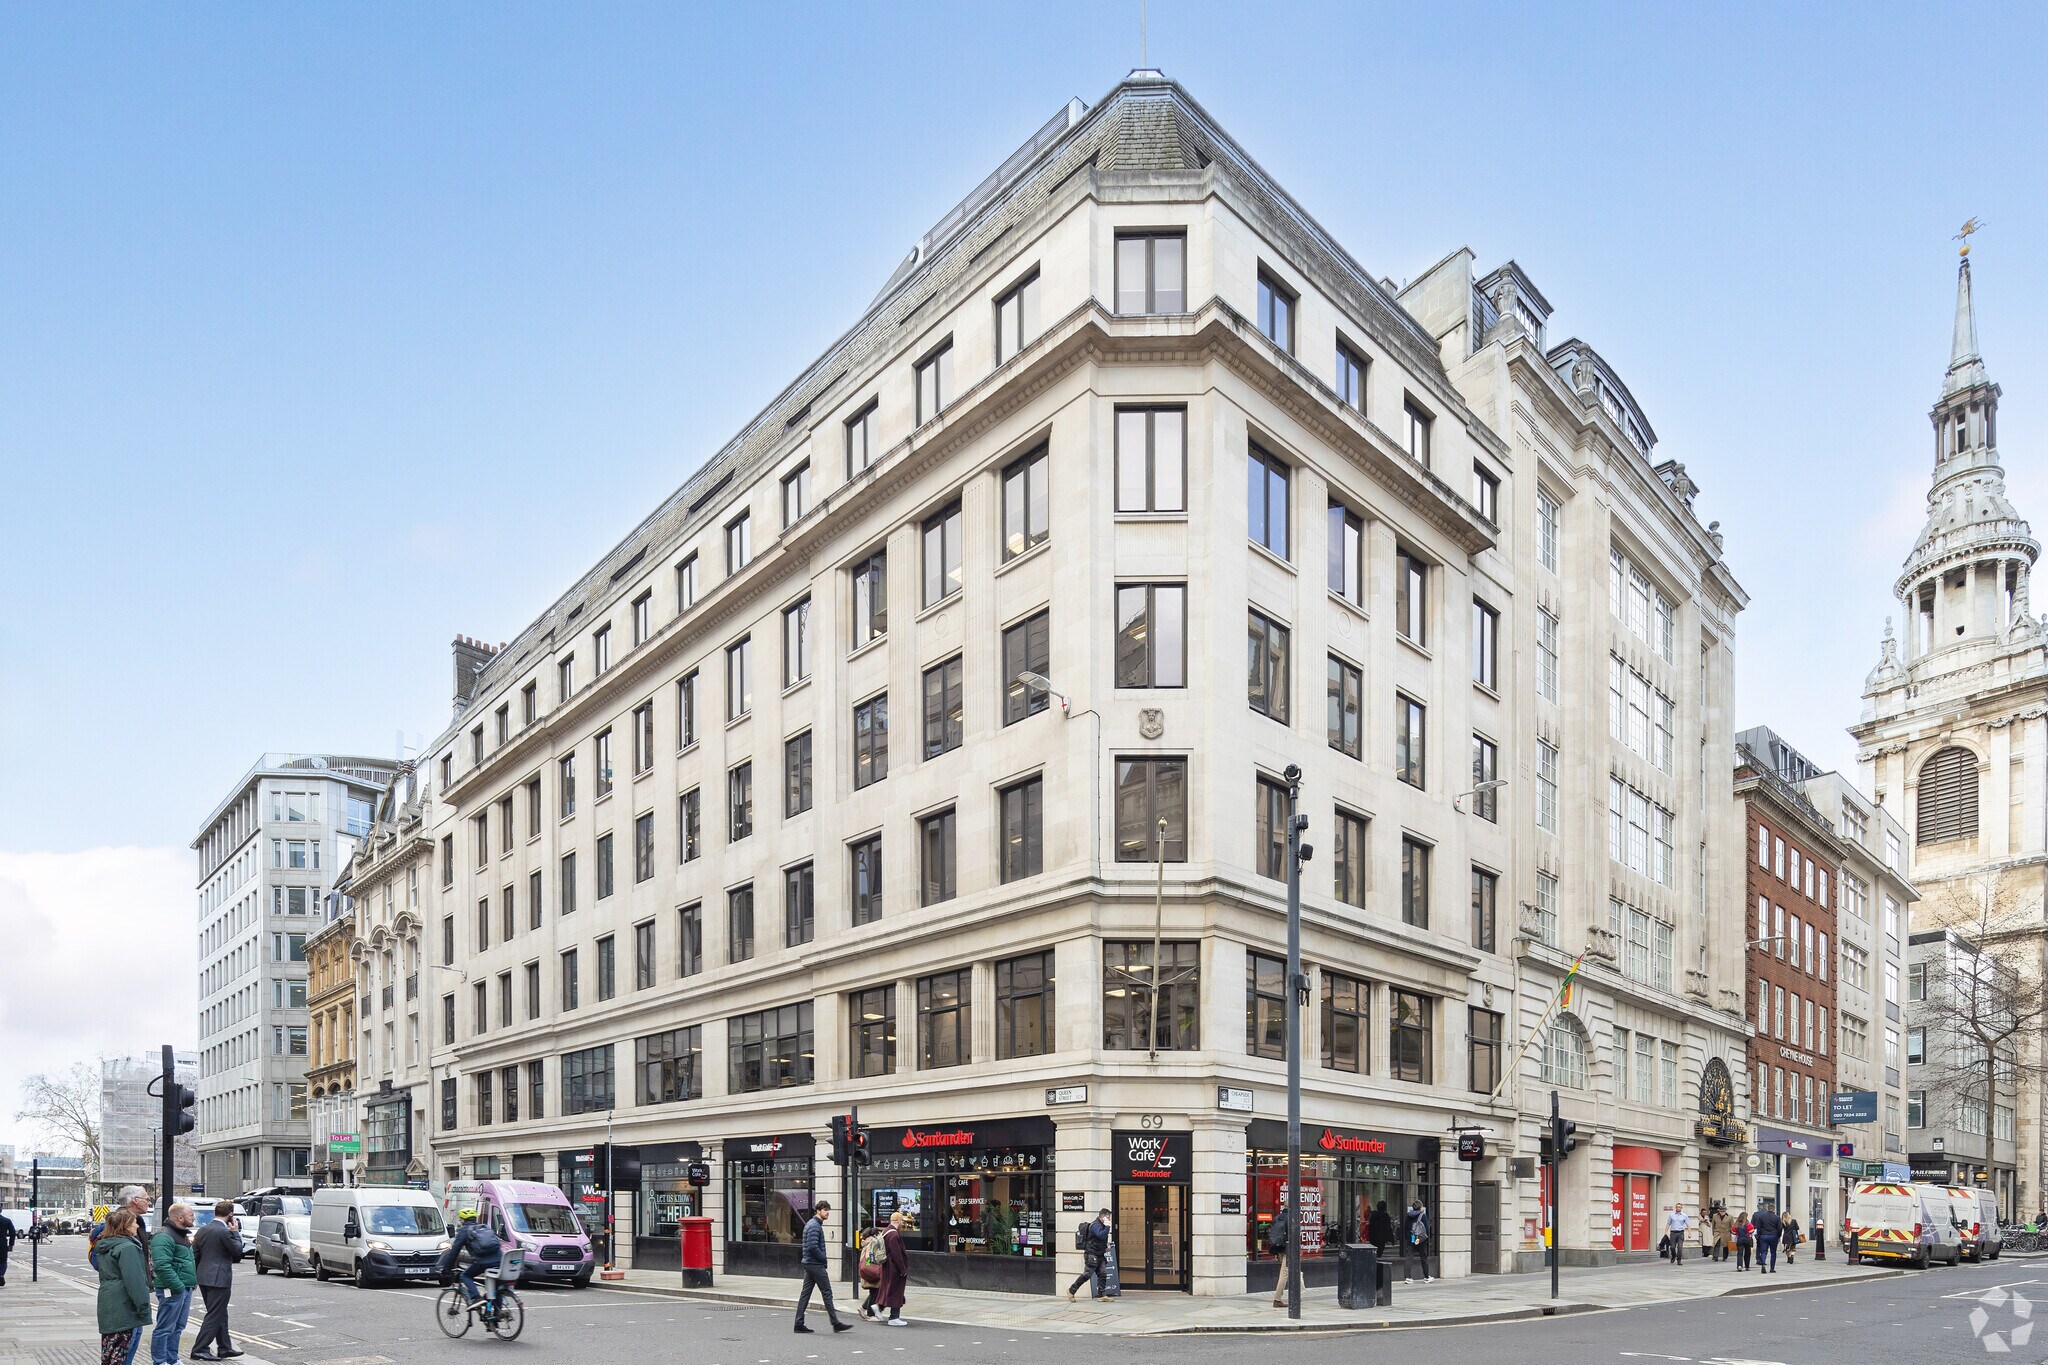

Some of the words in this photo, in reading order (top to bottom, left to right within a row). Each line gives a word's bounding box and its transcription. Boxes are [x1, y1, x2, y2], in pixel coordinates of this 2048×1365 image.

[1799, 1053, 1813, 1067] HOUSE
[1141, 1114, 1163, 1129] 69
[916, 1130, 975, 1146] Santander
[1128, 1137, 1161, 1149] Work
[1334, 1134, 1387, 1153] Santander
[1128, 1149, 1156, 1161] Café
[1132, 1169, 1171, 1178] Santander
[656, 1195, 665, 1203] LET
[666, 1195, 674, 1203] US
[674, 1194, 690, 1203] KNOW
[667, 1206, 691, 1222] HELP
[958, 1237, 986, 1245] CO-WORKING
